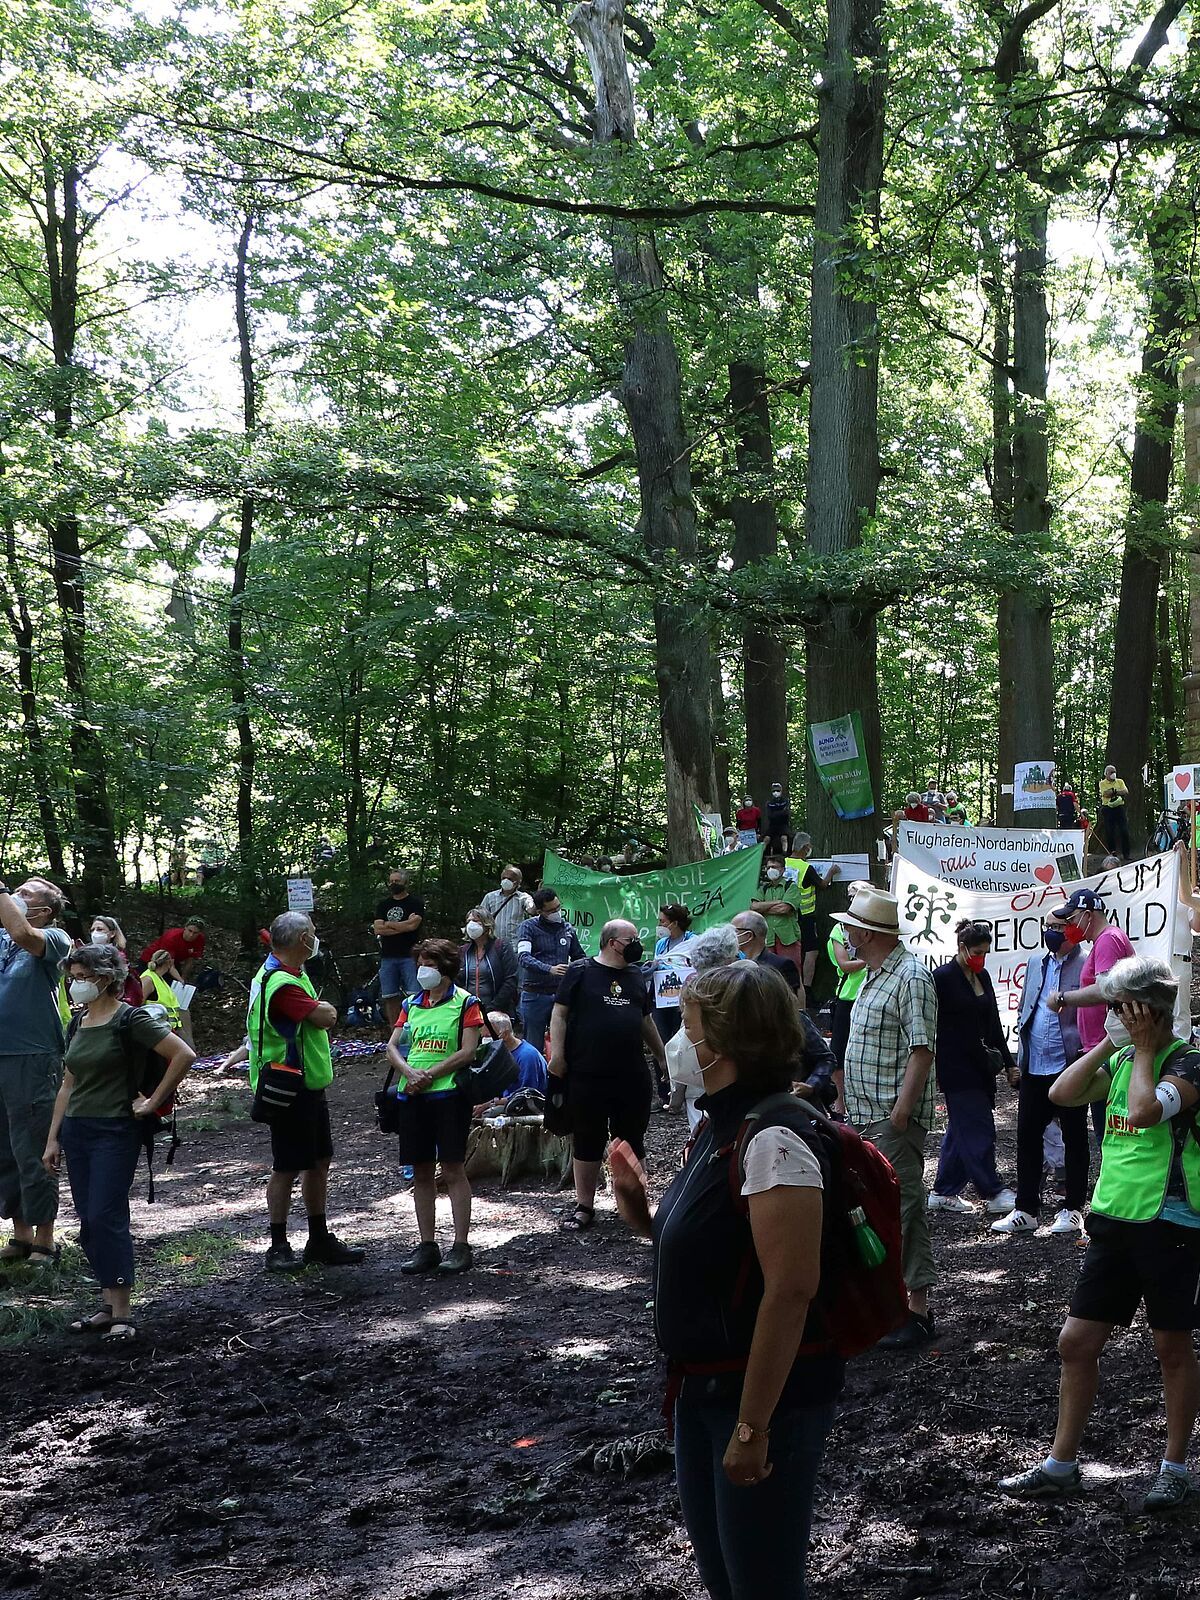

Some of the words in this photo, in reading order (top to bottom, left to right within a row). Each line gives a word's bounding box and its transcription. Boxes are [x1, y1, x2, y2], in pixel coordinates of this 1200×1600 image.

[906, 830, 1074, 854] Flughafen-Nordanbindung
[940, 851, 977, 873] raus
[983, 860, 1006, 872] aus
[1011, 886, 1069, 912] JA
[417, 1040, 448, 1049] NEIN!
